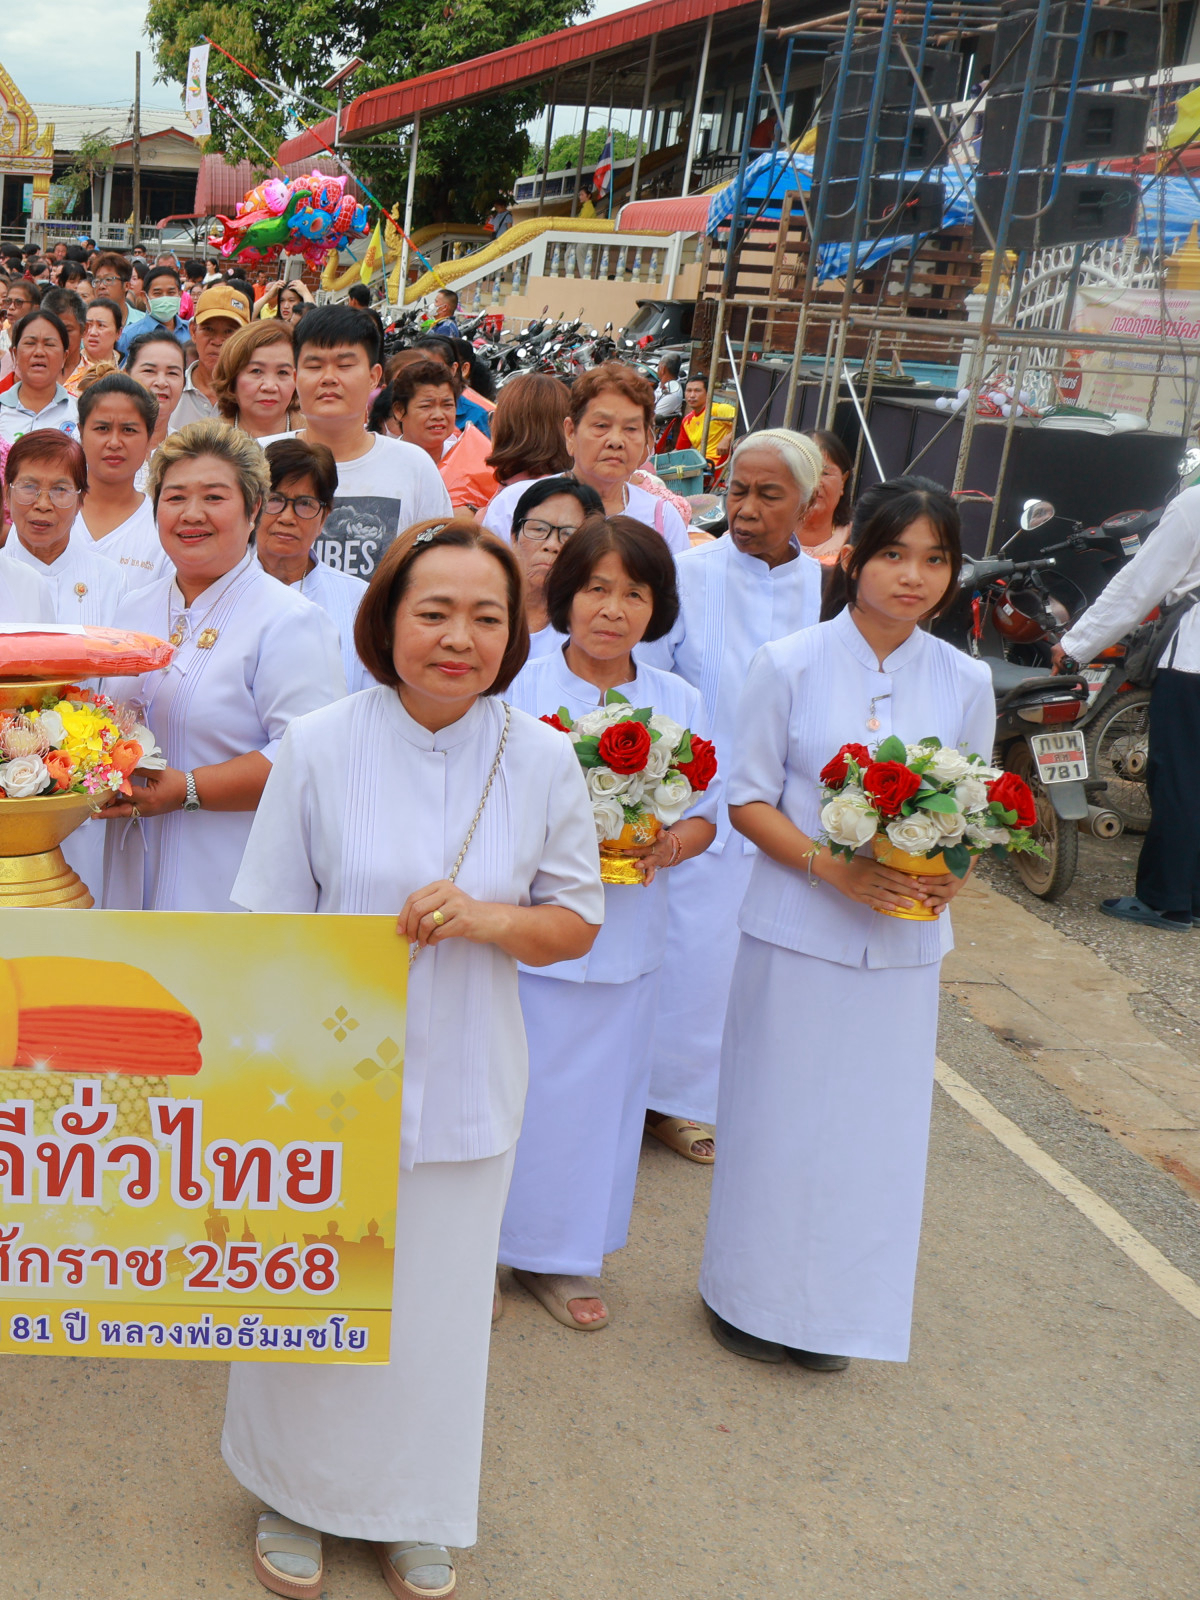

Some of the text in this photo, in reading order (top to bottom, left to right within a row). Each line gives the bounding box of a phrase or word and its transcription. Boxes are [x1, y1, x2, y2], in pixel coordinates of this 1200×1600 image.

[312, 540, 377, 575] IBES
[1044, 763, 1081, 780] 781
[189, 1246, 335, 1290] 2568
[13, 1317, 50, 1340] 81
[62, 1312, 86, 1341] ปี
[102, 1316, 366, 1349] หลวงพ่อธัมมชโย
